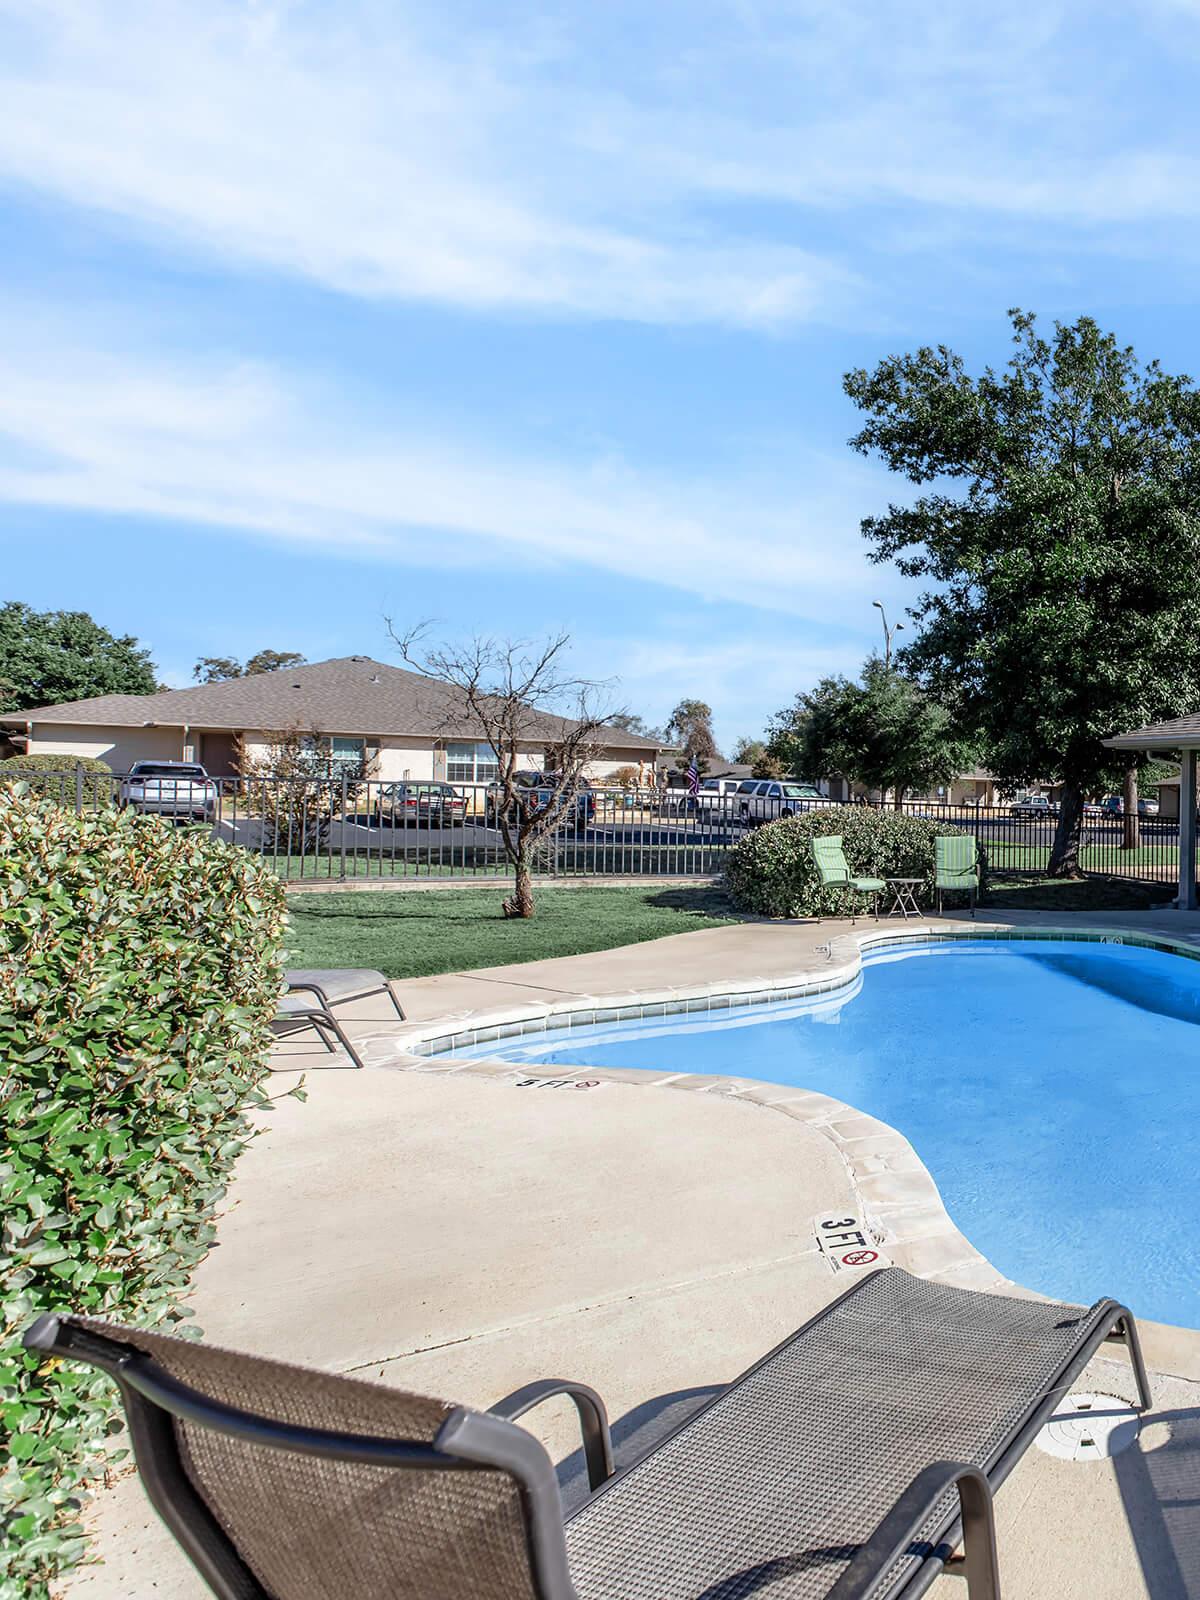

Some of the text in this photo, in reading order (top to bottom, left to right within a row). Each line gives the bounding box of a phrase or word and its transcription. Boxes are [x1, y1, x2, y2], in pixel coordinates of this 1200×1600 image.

[537, 1079, 575, 1088] FT
[821, 1218, 867, 1249] 3 FT
